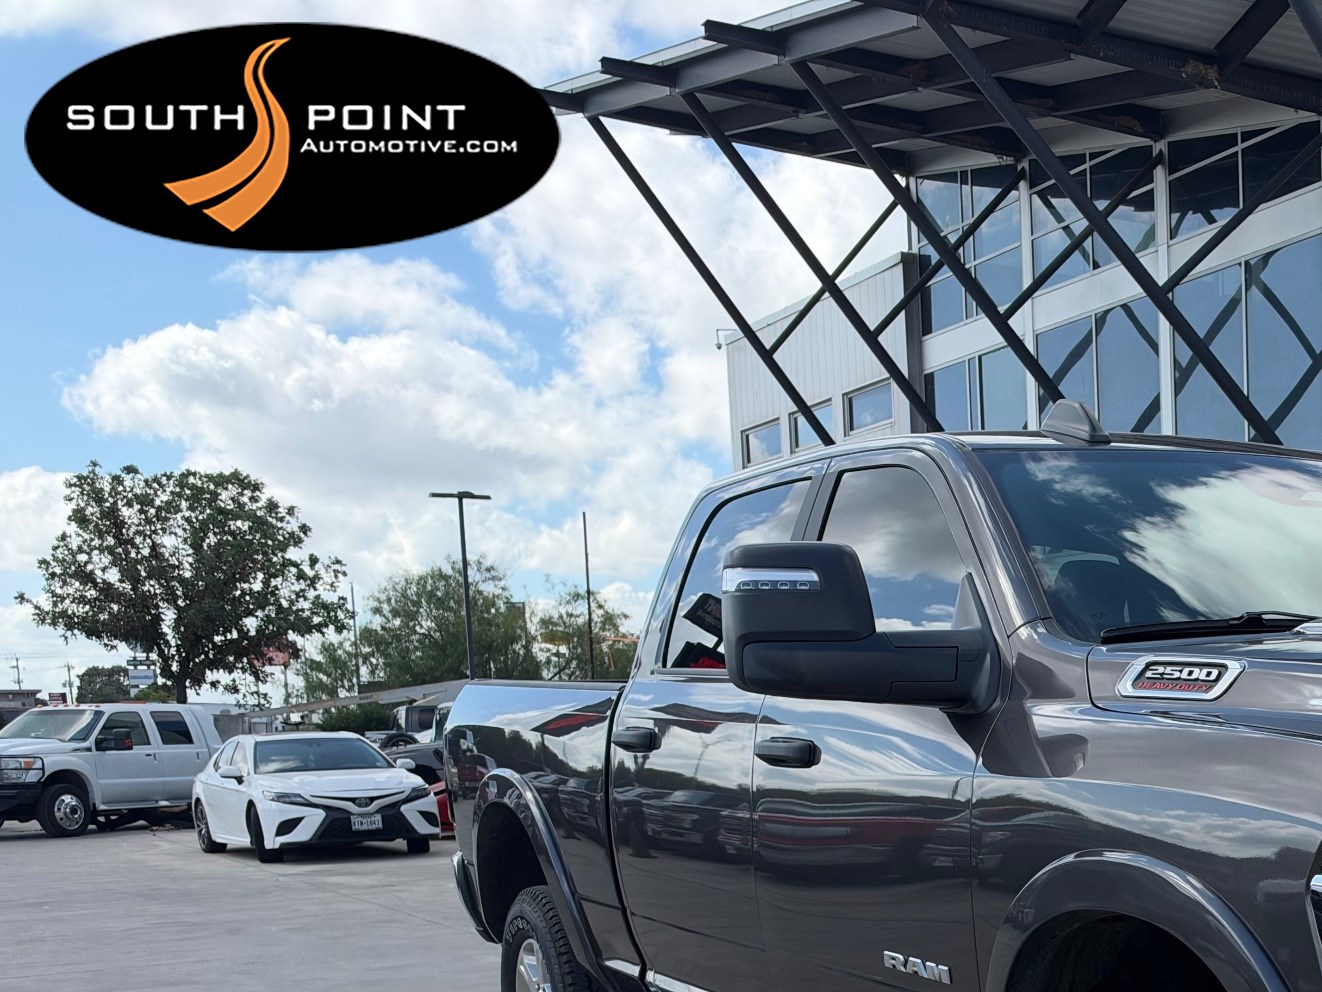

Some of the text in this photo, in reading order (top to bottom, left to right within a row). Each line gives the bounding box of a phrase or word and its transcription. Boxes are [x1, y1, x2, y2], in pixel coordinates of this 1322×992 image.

[1145, 666, 1220, 681] 2500
[1138, 682, 1212, 692] HEAVY DUTY
[883, 950, 952, 985] RAM
